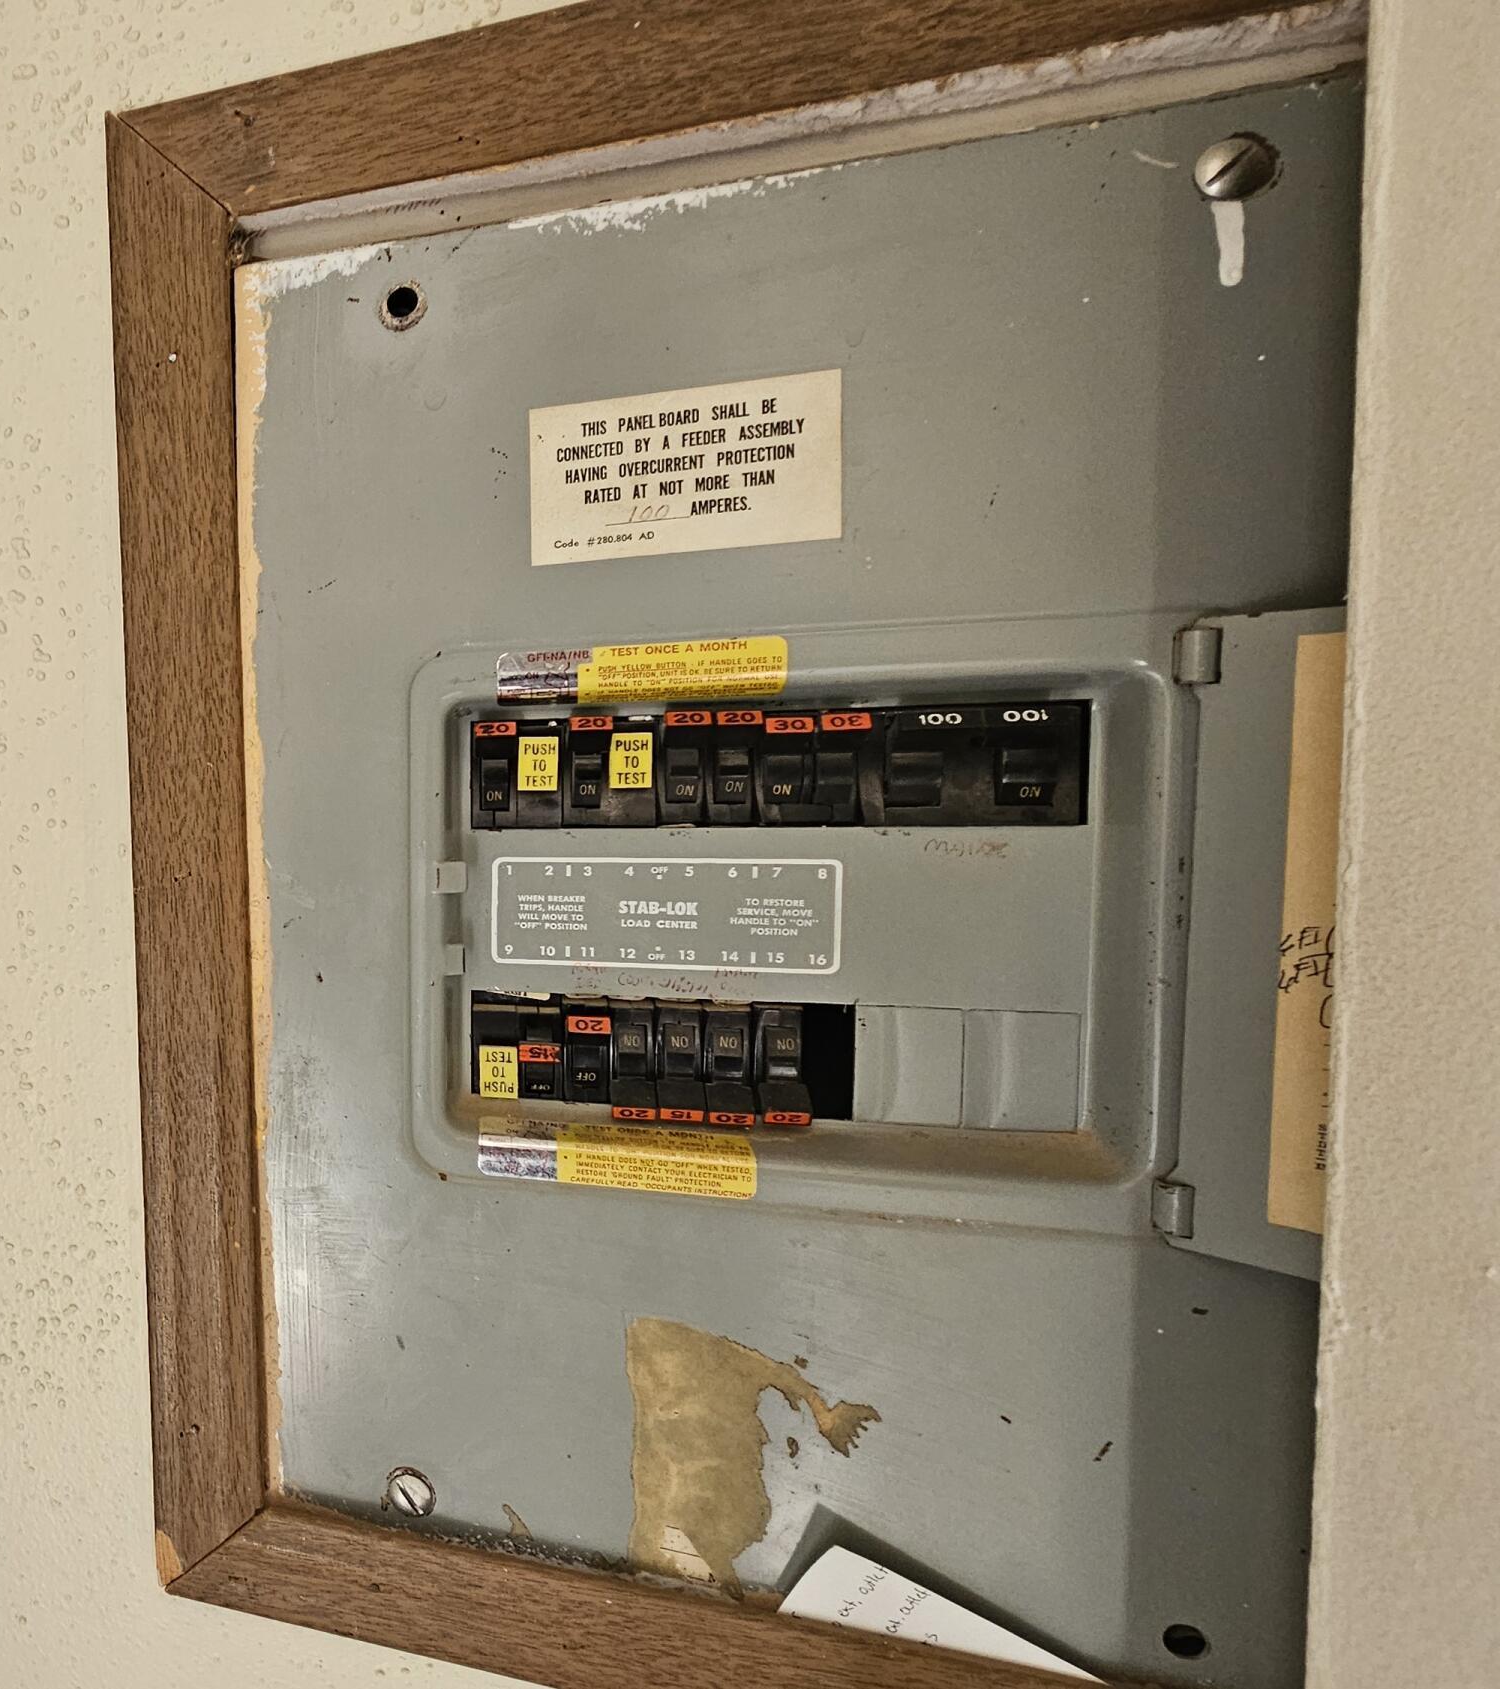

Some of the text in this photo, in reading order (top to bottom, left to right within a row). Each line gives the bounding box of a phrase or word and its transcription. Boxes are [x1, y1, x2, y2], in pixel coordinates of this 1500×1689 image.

[581, 420, 607, 437] THIS
[711, 402, 750, 420] SHALL
[761, 398, 778, 414] BE
[556, 418, 805, 462] CONNECTED BY A FEEDER ASSEMBLY
[565, 443, 795, 484] HAVING OVERCURRENT PROTECTION
[584, 469, 775, 504] RATED AT NOT MORE THAN
[628, 497, 752, 523] 100 AMPERES.
[554, 539, 579, 549] Code
[638, 531, 655, 541] AD
[610, 641, 747, 657] TEST ONCE A MONTH
[598, 665, 617, 674] PUSH
[621, 662, 652, 671] YELLOW
[656, 661, 686, 670] BUTTON
[709, 658, 741, 666] HANDLE
[746, 656, 767, 664] GOES
[660, 670, 677, 678] UNIT
[714, 666, 734, 674] SURE
[598, 680, 628, 688] HANDLE
[577, 718, 607, 728] 20
[674, 713, 756, 723] 20 20
[918, 713, 963, 725] 100
[774, 719, 808, 731] 30
[524, 743, 556, 755] PUSH
[615, 739, 648, 752] PUSH
[532, 760, 547, 771] TO
[625, 756, 640, 769] TO
[525, 775, 553, 787] TEST
[616, 772, 647, 785] TEST
[579, 784, 596, 795] ON
[676, 784, 695, 796] ON
[725, 781, 744, 792] ON
[772, 784, 792, 796] ON
[1019, 786, 1041, 798] ON
[486, 790, 502, 801] ON
[506, 865, 827, 879] 1 2 3 4 OFF 5 6 7 8
[547, 895, 586, 903] BREAKER
[745, 898, 805, 907] TO RESTORE
[518, 904, 584, 912] TRIPS, HANDLE
[618, 900, 698, 916] STAB-LOK
[736, 907, 813, 917] SERVICE, MOVE
[544, 923, 588, 931] POSITION
[621, 919, 698, 929] LOAD CENTER
[729, 917, 770, 925] HANDLE
[750, 928, 798, 936] POSITION
[504, 944, 513, 954] 9
[539, 946, 556, 956] 10
[580, 947, 595, 957] 11
[619, 948, 636, 959] 12
[679, 950, 695, 961] 13
[721, 951, 739, 962] 14
[767, 952, 784, 963] 15
[808, 954, 827, 965] 16
[575, 1019, 603, 1031] 20
[624, 1034, 640, 1047] ON
[671, 1035, 689, 1048] ON
[719, 1035, 738, 1048] ON
[777, 1038, 795, 1050] ON
[486, 1051, 513, 1063] TEST
[491, 1067, 505, 1078] TO
[576, 1072, 596, 1081] OFF
[484, 1081, 514, 1093] PUSH
[618, 1108, 649, 1118] 20
[670, 1110, 693, 1120] 15
[715, 1113, 749, 1123] 20
[772, 1114, 802, 1123] 20
[586, 1154, 615, 1162] HANDLE
[618, 1156, 638, 1164] DOES
[640, 1158, 654, 1166] NOT
[697, 1163, 718, 1171] WHEN
[576, 1161, 627, 1171] IMMEDIATELY
[628, 1165, 661, 1174] CONTACT
[664, 1168, 685, 1177] YOUR
[689, 1170, 738, 1181] ELECTRICIAN
[576, 1169, 607, 1177] RESTORE
[570, 1176, 614, 1185] CAREFULLY
[620, 1180, 638, 1188] READ
